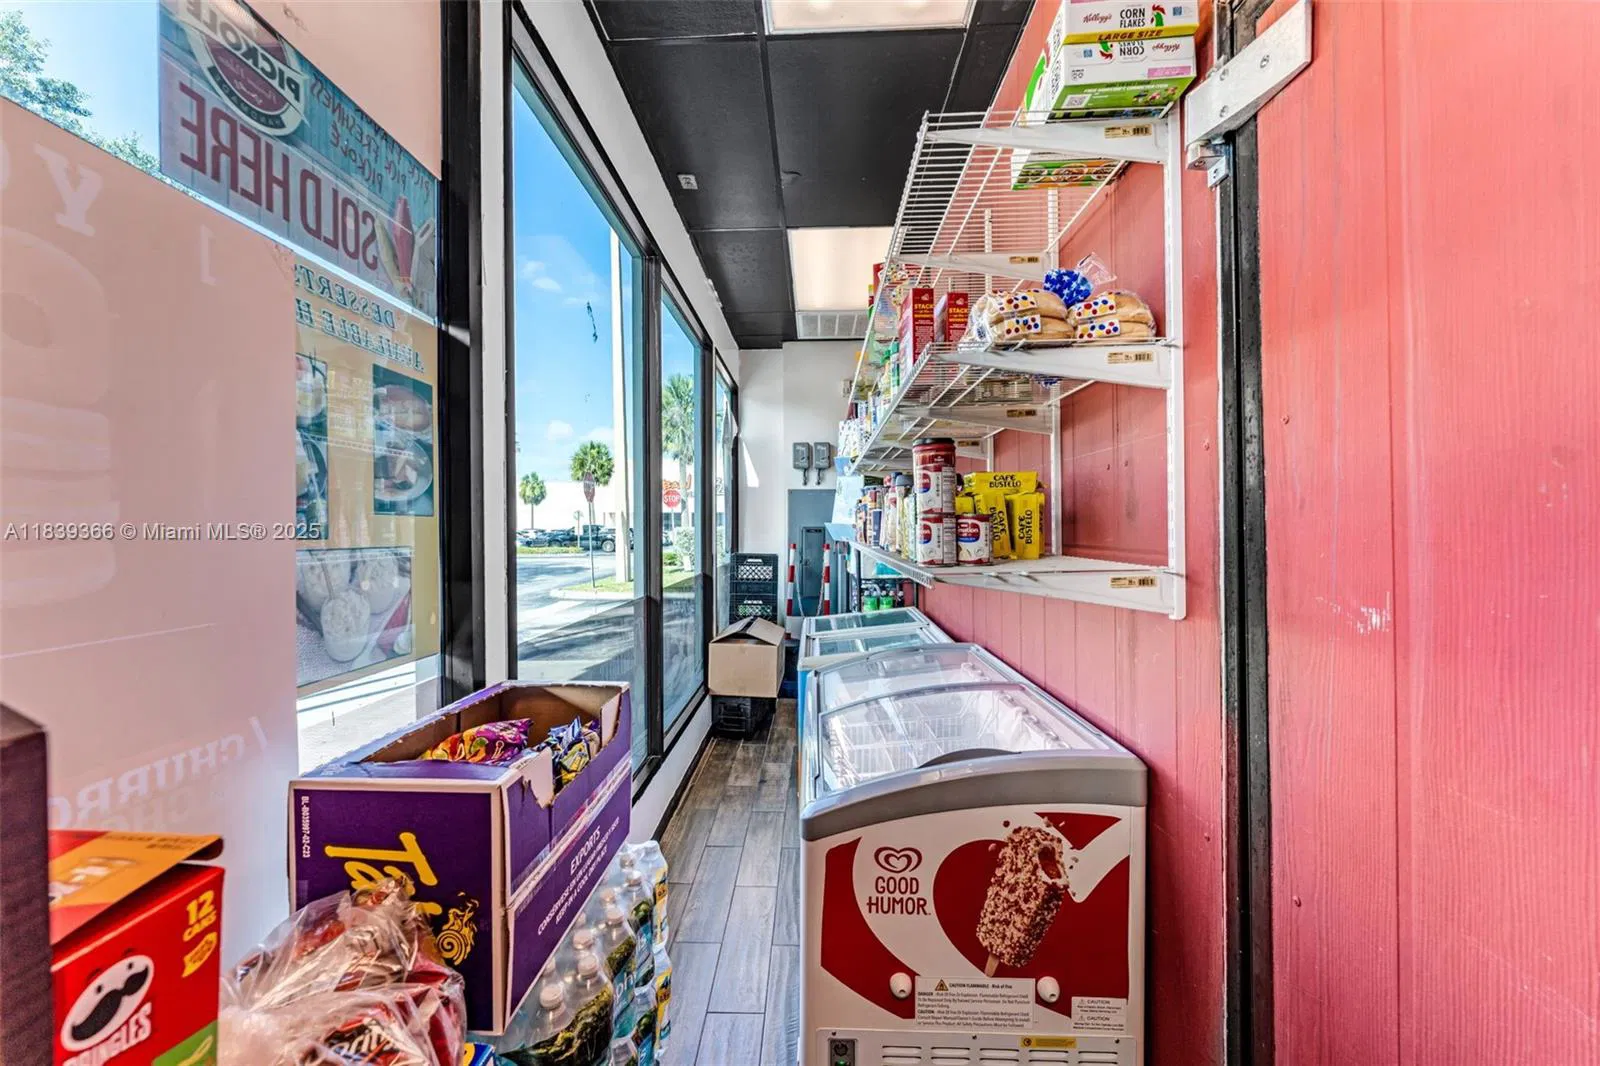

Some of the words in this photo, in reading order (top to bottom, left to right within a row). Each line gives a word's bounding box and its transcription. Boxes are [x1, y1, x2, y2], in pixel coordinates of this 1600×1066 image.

[1083, 13, 1112, 23] Kellogg's
[1120, 8, 1145, 19] CORN
[1120, 18, 1145, 28] FLAKES
[1097, 31, 1136, 41] LARGE
[1136, 29, 1164, 38] SIZE
[1119, 46, 1145, 56] CORN
[989, 480, 1022, 488] BUSTELO
[1025, 509, 1033, 545] BUSTELO
[570, 825, 601, 876] EXPORTS
[875, 876, 919, 895] GOOD
[186, 890, 215, 925] 12
[866, 896, 928, 915] HUMOR
